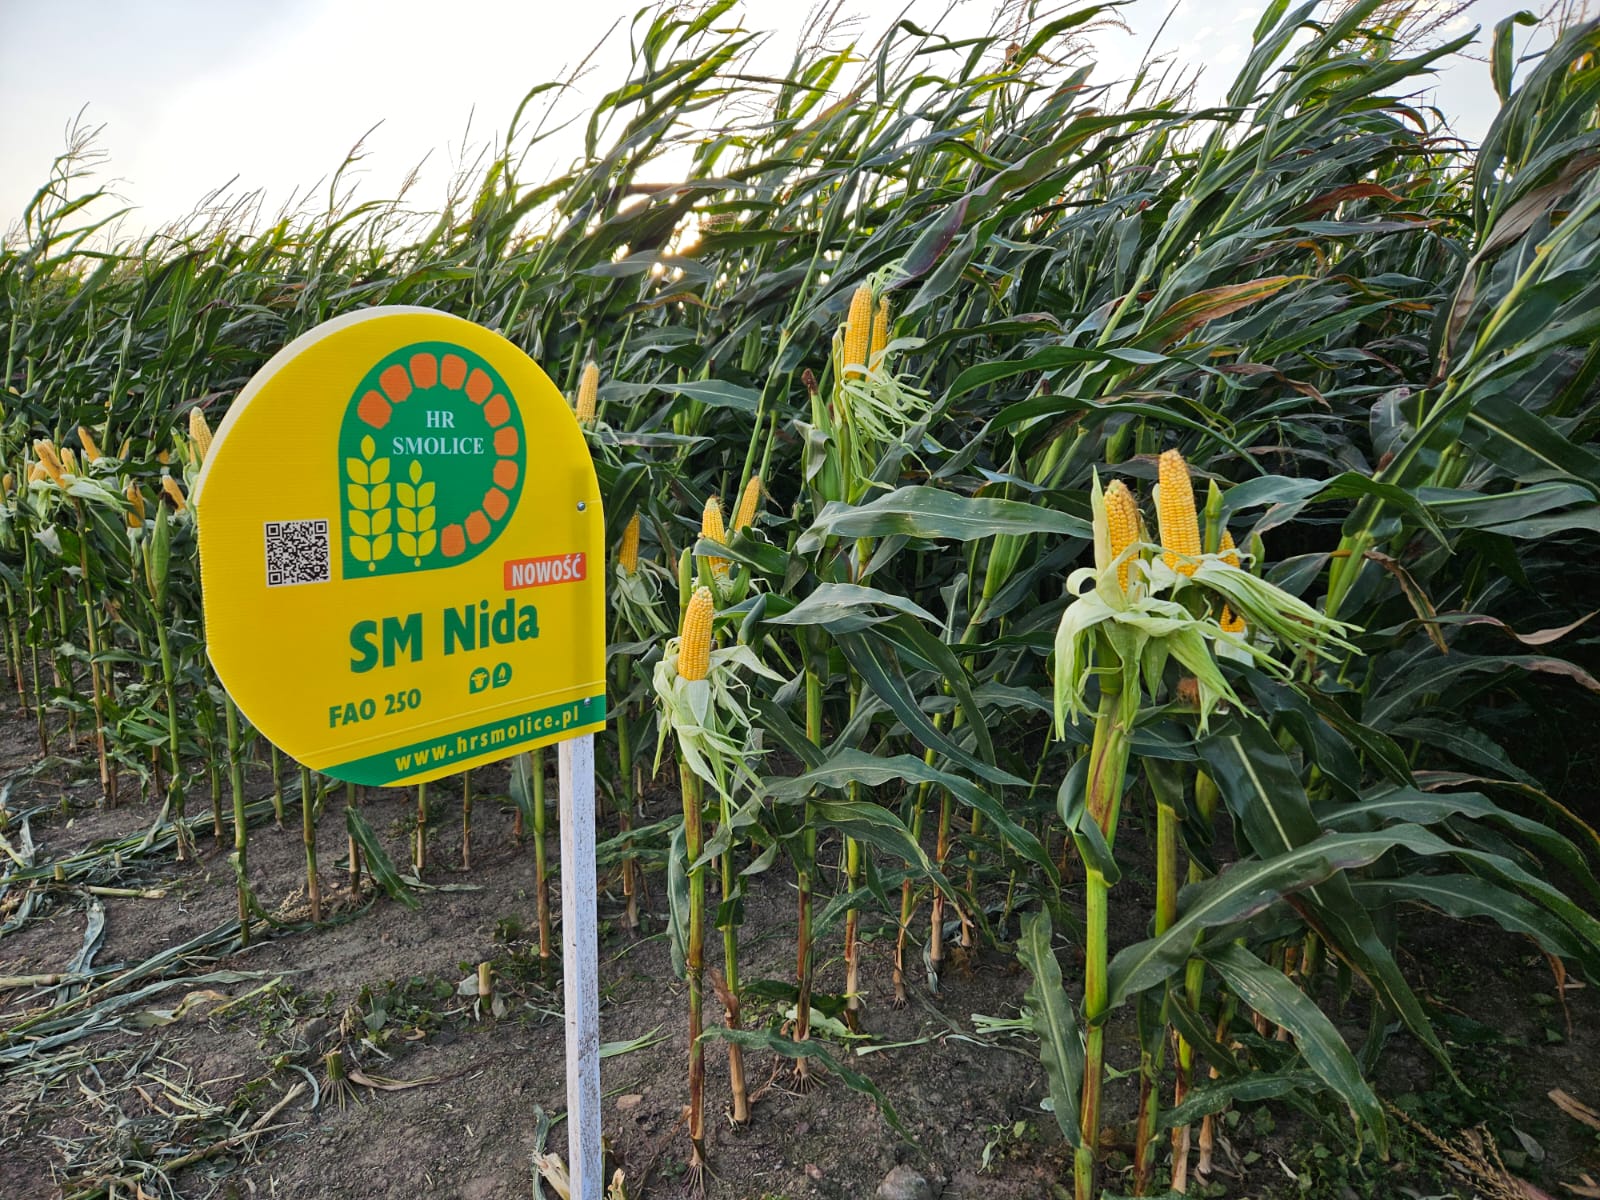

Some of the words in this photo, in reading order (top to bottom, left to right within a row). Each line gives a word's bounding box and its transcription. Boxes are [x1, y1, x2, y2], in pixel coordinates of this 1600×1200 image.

[425, 410, 455, 429] HR
[392, 436, 485, 456] SMOLICE
[511, 553, 582, 587] NOWOŚĆ
[349, 612, 423, 674] SM
[443, 597, 540, 656] Nida
[328, 697, 376, 728] FAO
[384, 688, 422, 714] 250
[394, 705, 579, 772] www.hrsmolice.pl
